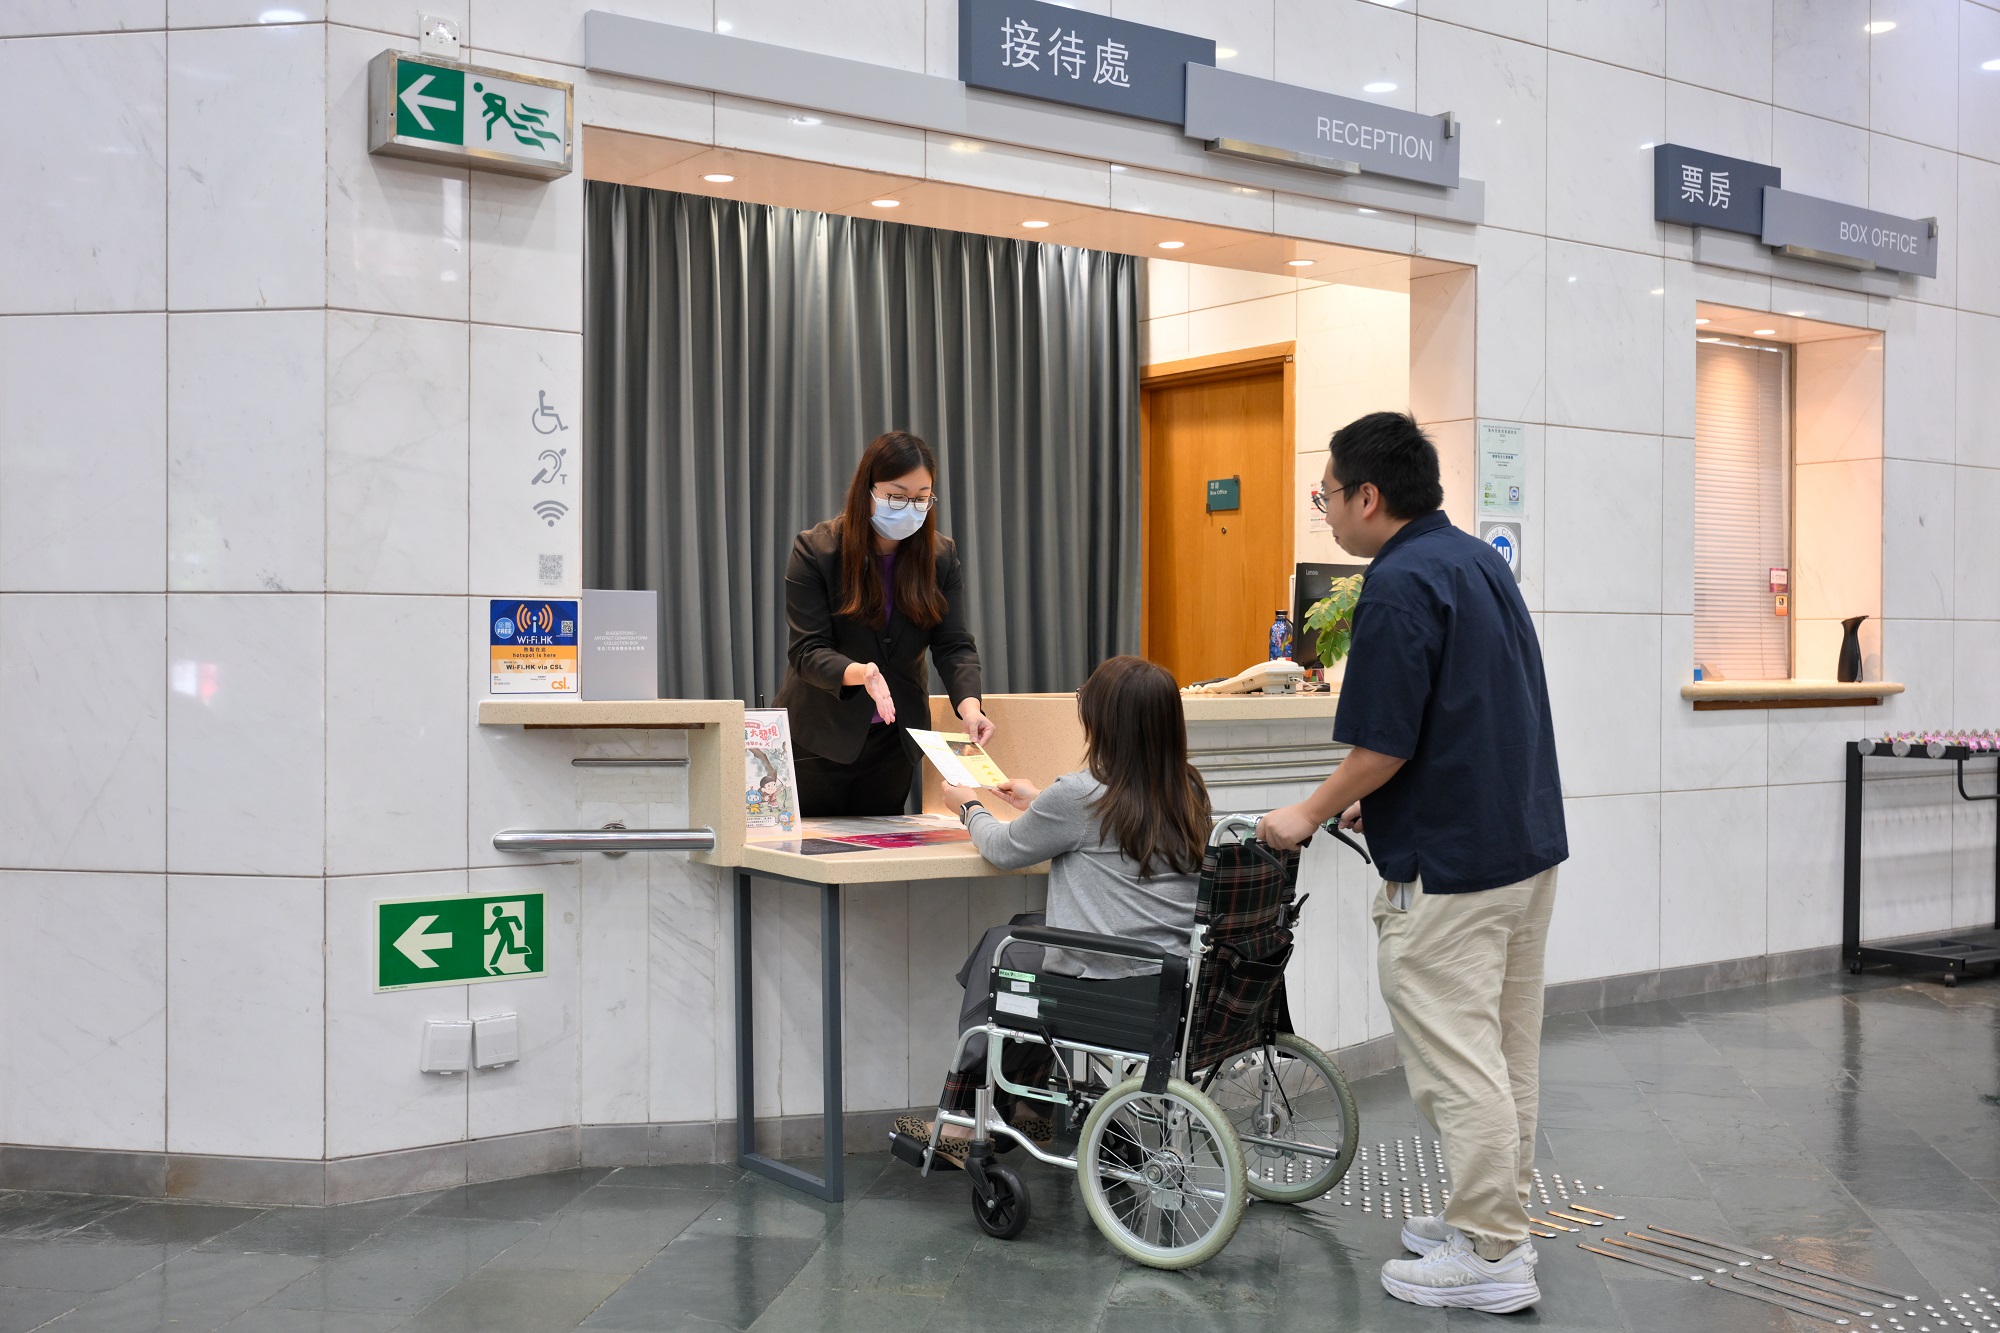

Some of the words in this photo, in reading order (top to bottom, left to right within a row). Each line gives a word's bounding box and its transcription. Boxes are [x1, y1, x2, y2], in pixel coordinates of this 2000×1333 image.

[1000, 16, 1131, 88] 接待處
[1317, 116, 1433, 162] RECEPTION
[1681, 164, 1731, 209] 票房
[1840, 221, 1868, 245] BOX
[1871, 228, 1918, 255] OFFICE
[516, 635, 553, 645] Wi-Fi.HK
